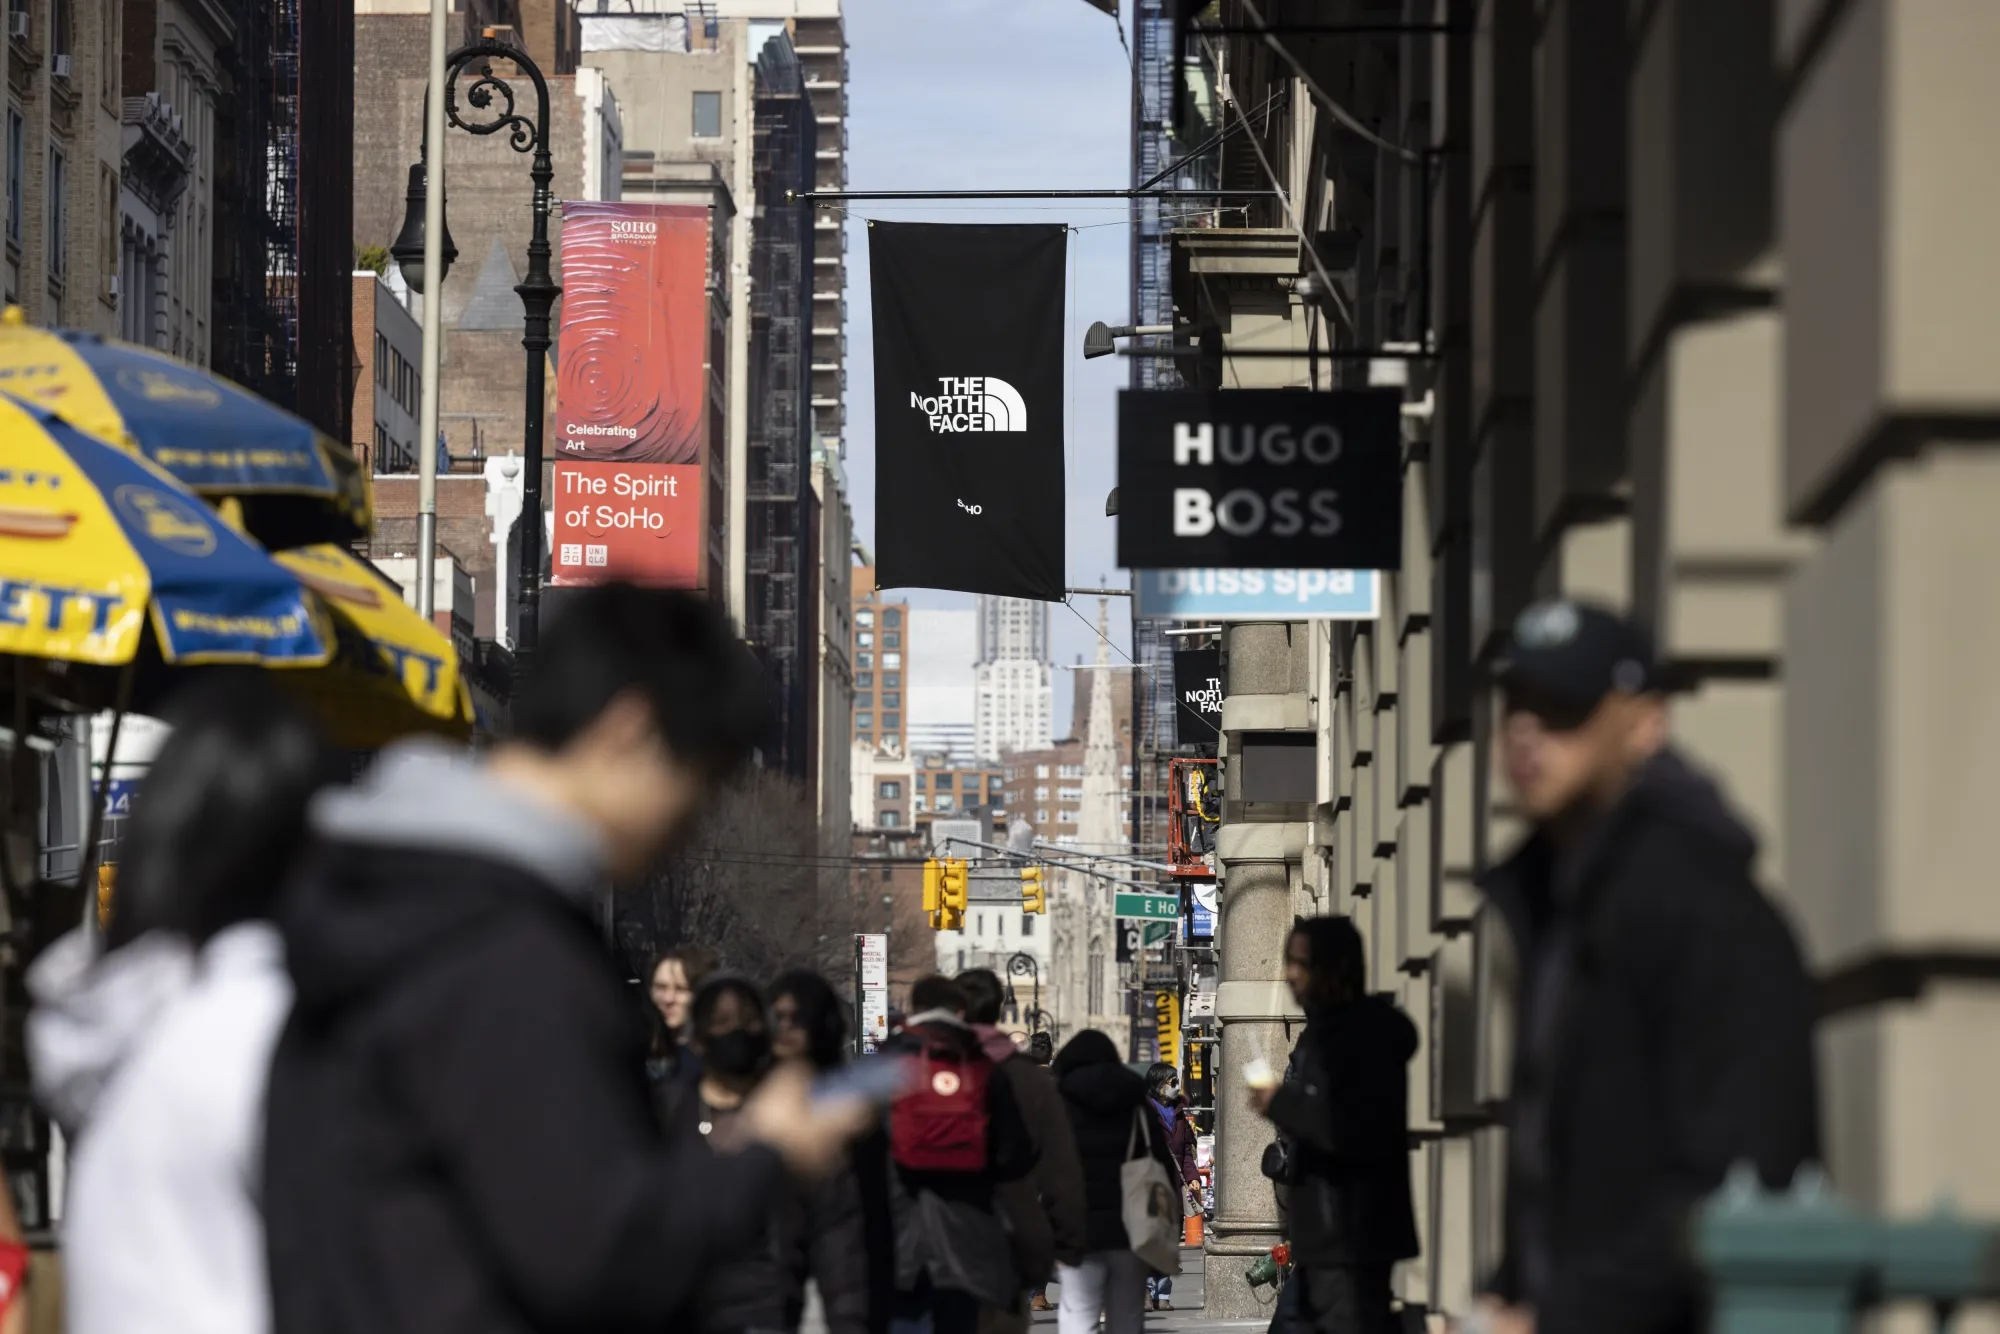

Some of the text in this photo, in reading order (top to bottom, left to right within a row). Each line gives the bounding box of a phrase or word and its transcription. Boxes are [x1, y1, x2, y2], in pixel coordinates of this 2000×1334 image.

[611, 220, 657, 233] SOHO
[938, 376, 983, 395] THE
[910, 391, 983, 415] NORTH
[566, 424, 637, 439] Celebrating
[929, 413, 983, 434] FACE
[565, 440, 585, 451] Art
[1173, 422, 1343, 465] HUGO
[561, 471, 678, 501] The Spirit
[957, 498, 983, 515] SHO
[1173, 488, 1343, 537] BOSS
[565, 505, 664, 529] of SoHo
[588, 547, 604, 555] UNI
[588, 555, 605, 564] QLO
[1158, 568, 1354, 602] bliss spa
[1144, 899, 1152, 913] E
